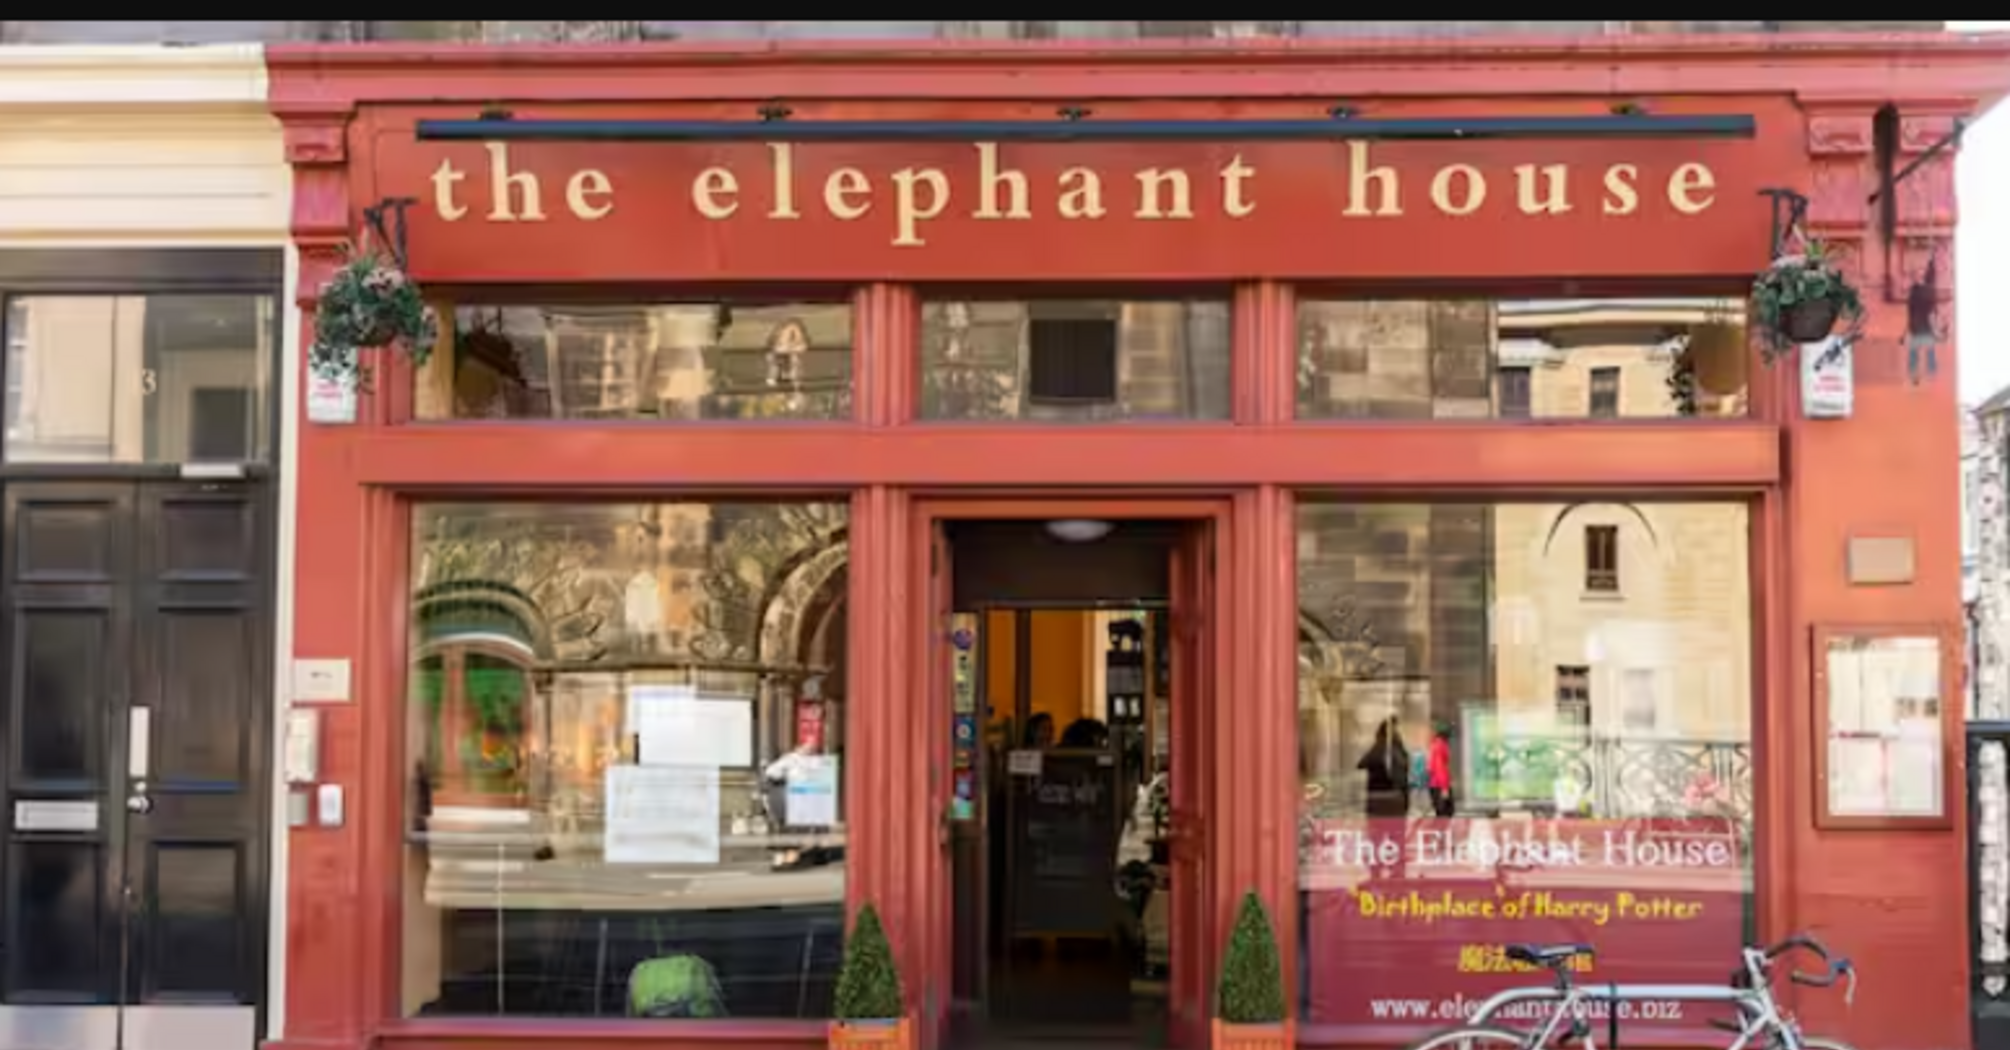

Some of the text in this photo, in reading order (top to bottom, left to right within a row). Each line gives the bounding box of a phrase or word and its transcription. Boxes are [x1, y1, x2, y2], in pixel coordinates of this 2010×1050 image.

[431, 139, 1715, 246] the elephant house
[1325, 828, 1731, 869] The Elephant House
[1501, 891, 1530, 919] of
[1534, 892, 1609, 925] Harry
[1616, 892, 1704, 920] Potter
